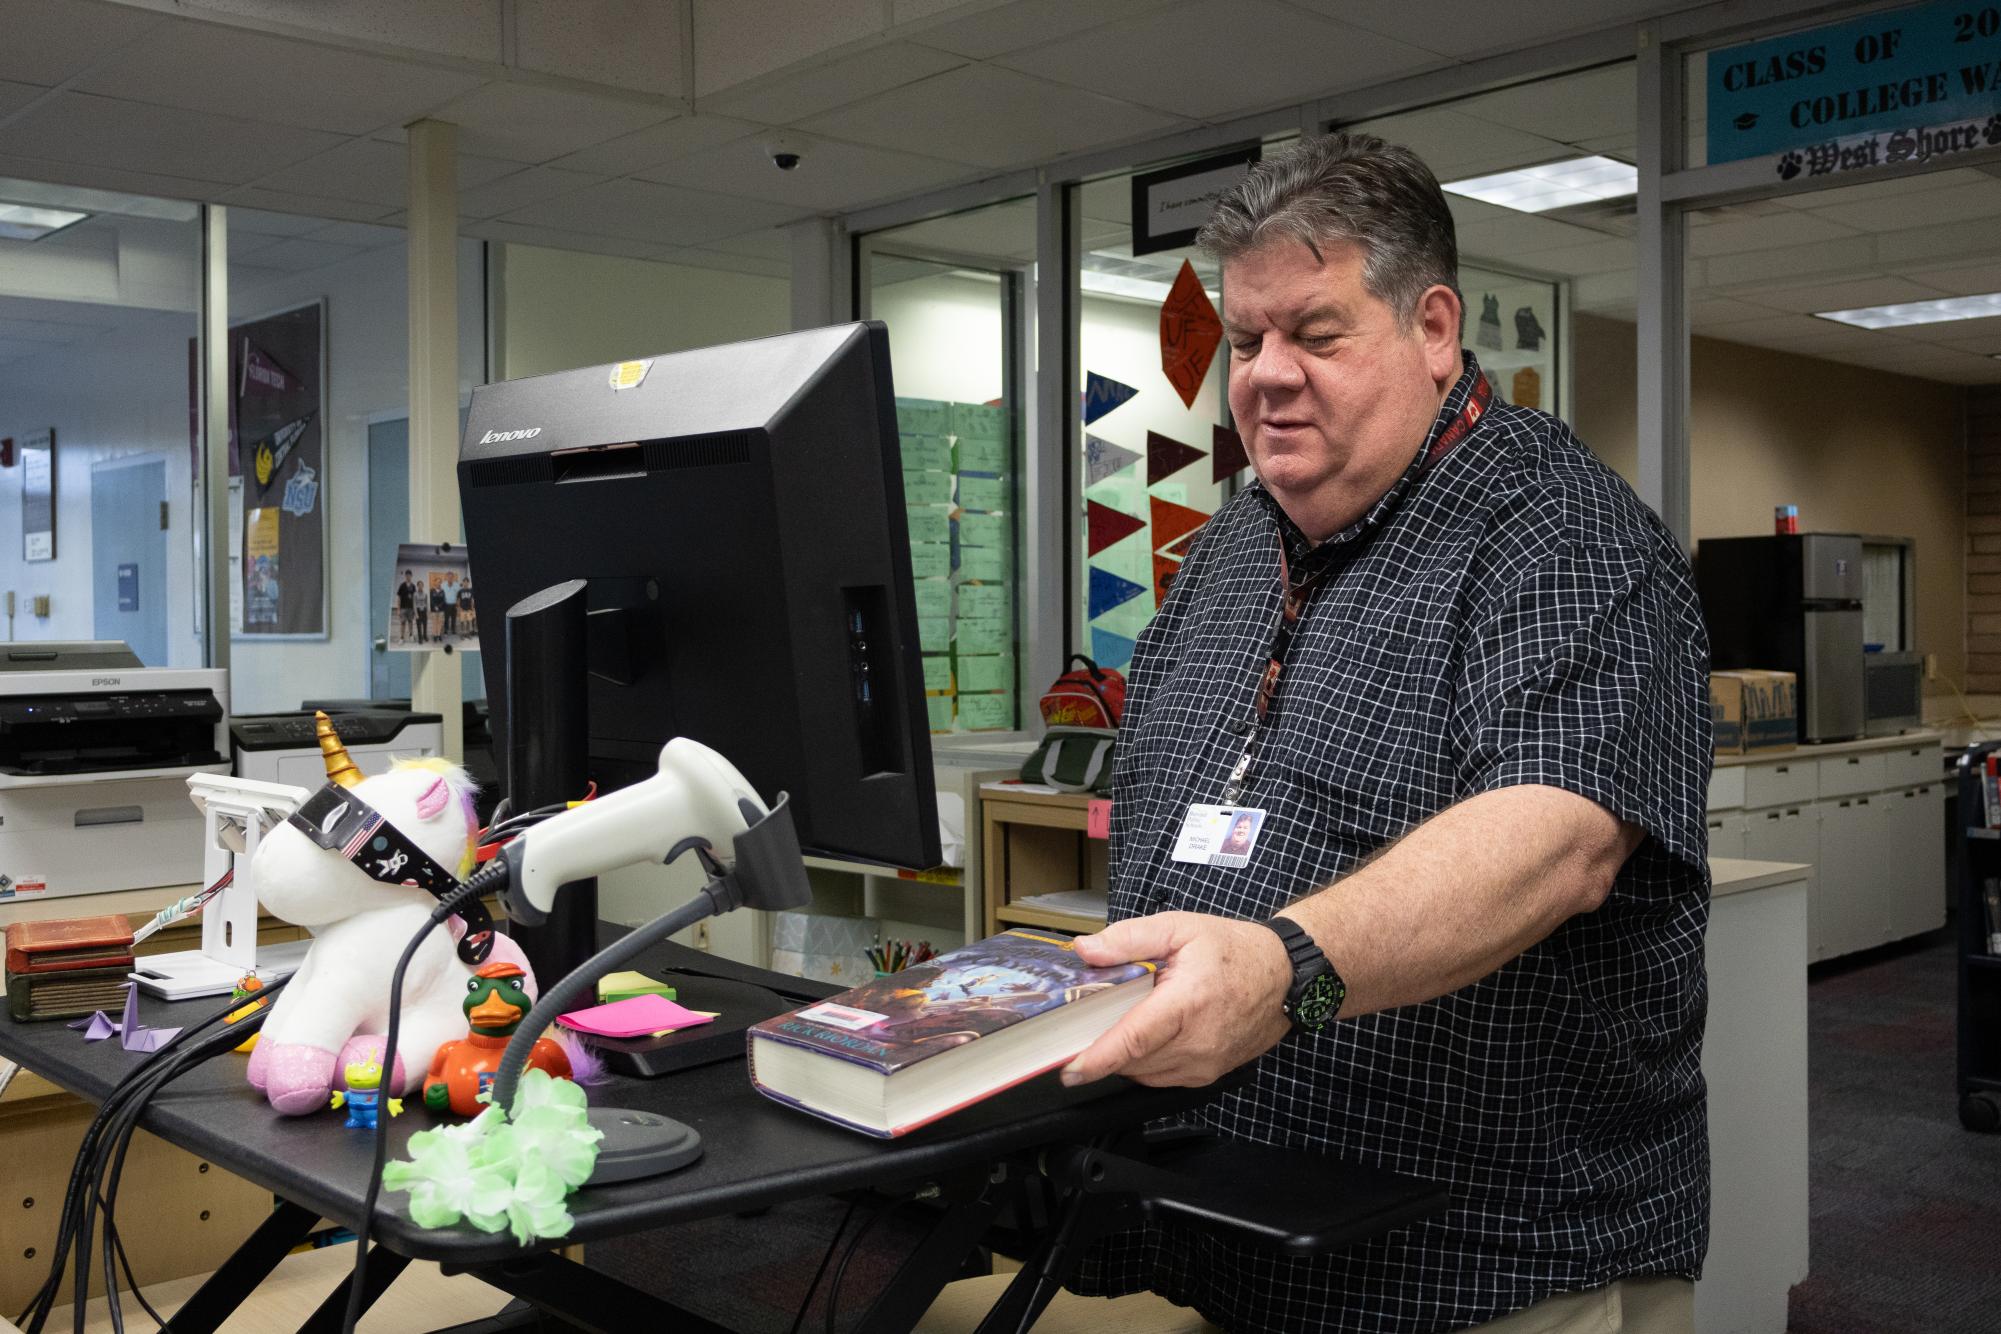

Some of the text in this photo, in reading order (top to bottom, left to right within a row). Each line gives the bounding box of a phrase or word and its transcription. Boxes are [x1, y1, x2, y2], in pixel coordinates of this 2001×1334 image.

[1723, 8, 2000, 92] CLASS OF 20
[1790, 72, 1948, 128] COLLEGE
[1806, 125, 1978, 176] West Shore
[1166, 314, 1198, 351] UF
[479, 427, 542, 445] lenovo
[91, 677, 121, 687] EPSON
